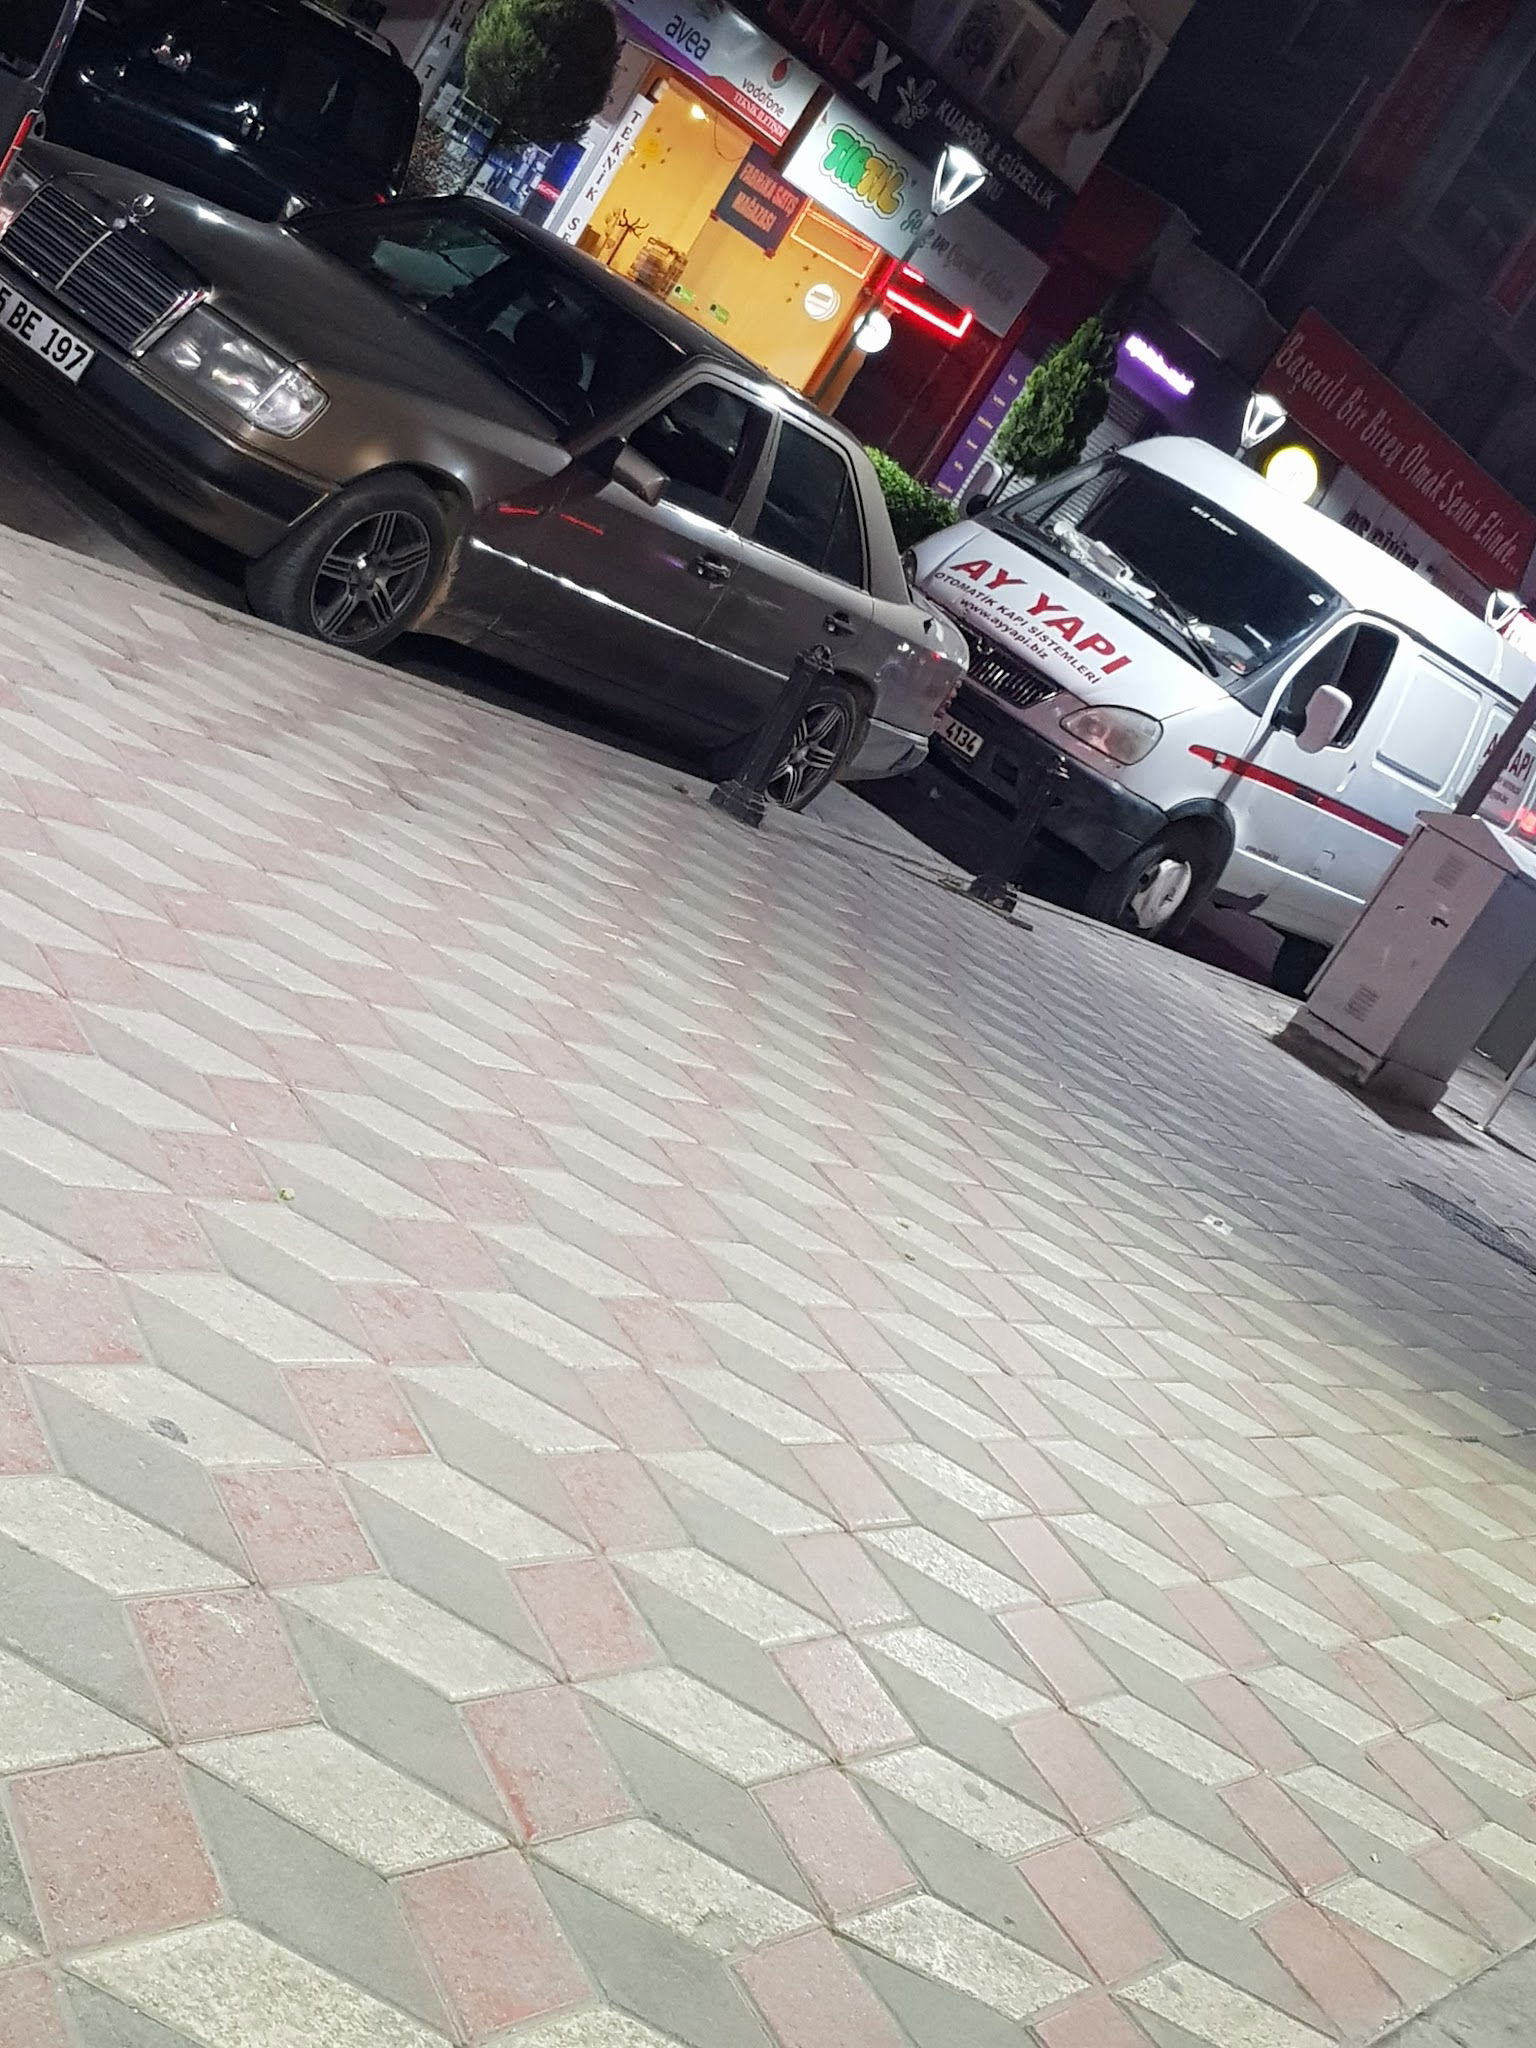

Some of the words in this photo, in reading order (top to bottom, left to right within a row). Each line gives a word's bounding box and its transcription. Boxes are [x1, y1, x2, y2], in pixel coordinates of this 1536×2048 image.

[665, 14, 711, 61] avea
[742, 78, 786, 118] vodafone
[585, 110, 642, 202] TEKNİK
[7, 301, 43, 341] BE
[41, 328, 88, 371] 197
[1276, 332, 1347, 410] Başarılı
[1337, 385, 1368, 431] Bir
[1360, 408, 1404, 468] Birey
[1399, 443, 1454, 503] Olmak
[1439, 480, 1482, 533] Senin
[934, 572, 998, 607] OTOMATİK
[996, 604, 1029, 627] KAPI
[1027, 625, 1102, 685] SİSTEMLERİ
[949, 559, 1028, 590] AY
[1026, 592, 1132, 675] YAPI
[960, 598, 1048, 660] www.ayyapi.biz
[945, 721, 978, 752] 4134
[1503, 749, 1535, 782] API
